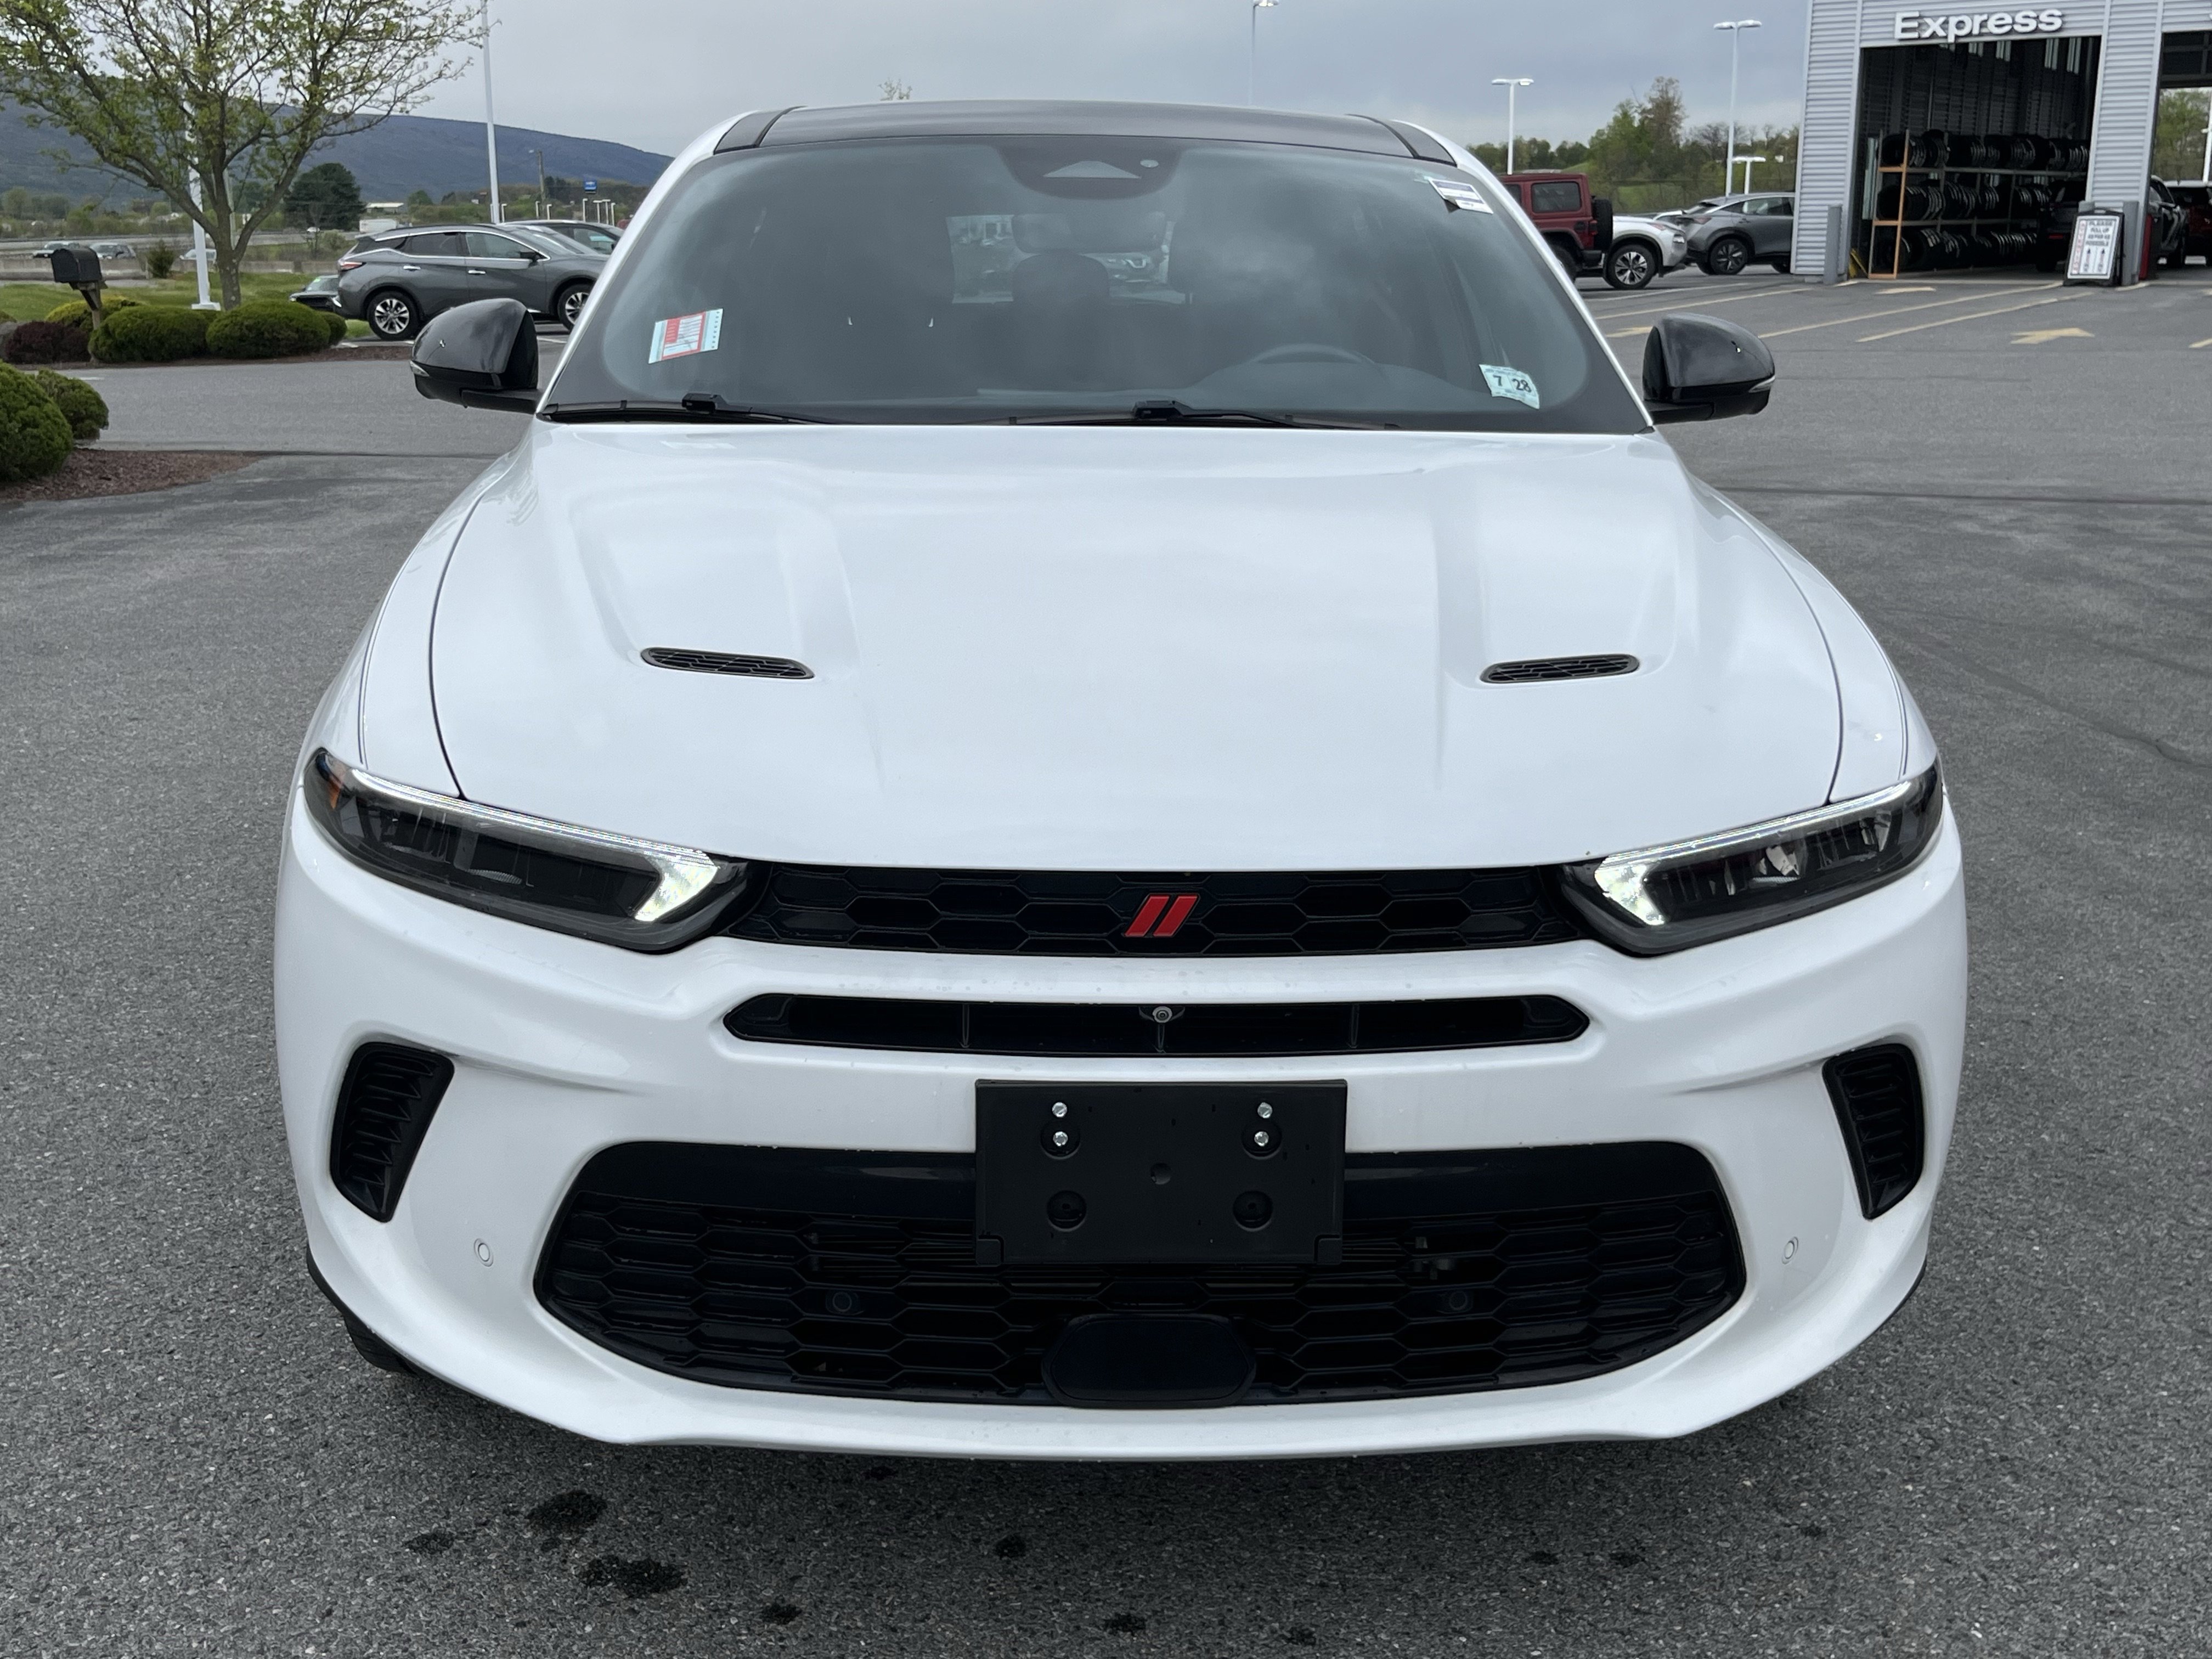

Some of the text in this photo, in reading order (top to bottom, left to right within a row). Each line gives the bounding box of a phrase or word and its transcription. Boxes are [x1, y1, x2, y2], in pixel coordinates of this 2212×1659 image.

[1894, 9, 2063, 43] Express
[1492, 375, 1532, 393] 7 28
